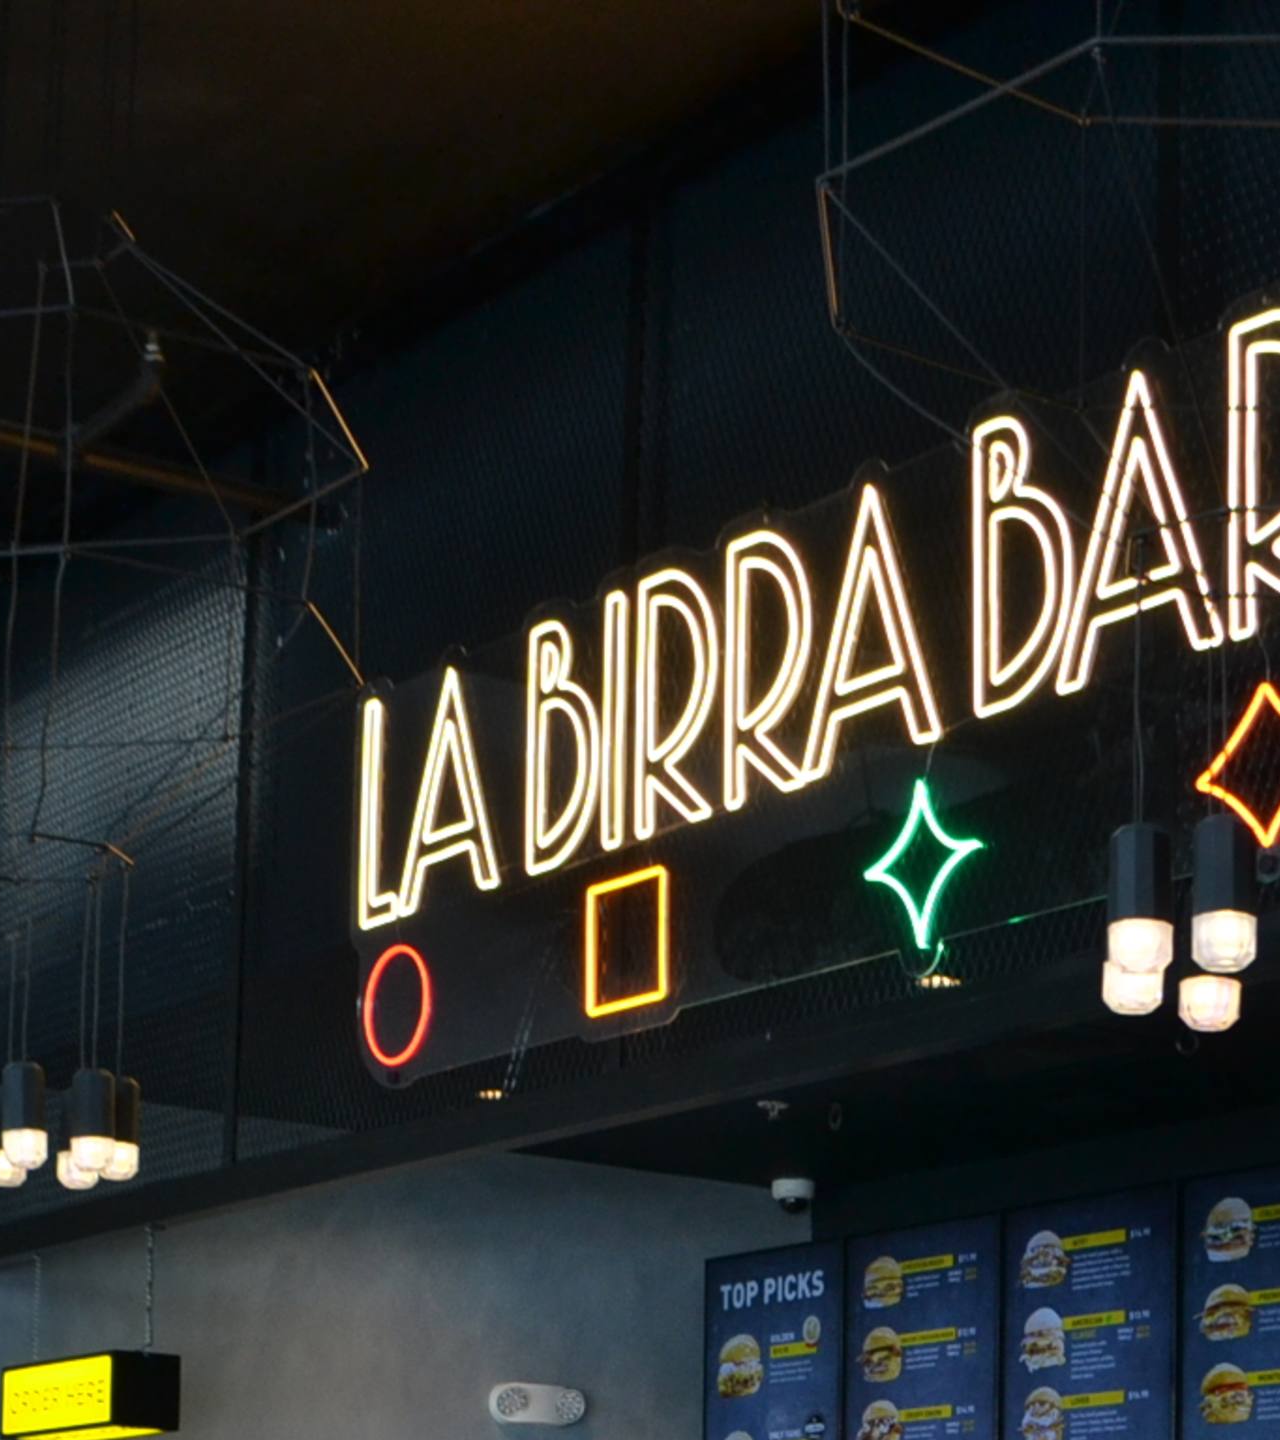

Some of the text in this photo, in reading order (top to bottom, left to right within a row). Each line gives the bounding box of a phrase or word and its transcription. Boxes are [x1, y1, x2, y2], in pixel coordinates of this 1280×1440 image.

[358, 668, 501, 931] LA
[525, 482, 941, 876] BIRRA
[719, 1270, 826, 1311] TOP PICKS
